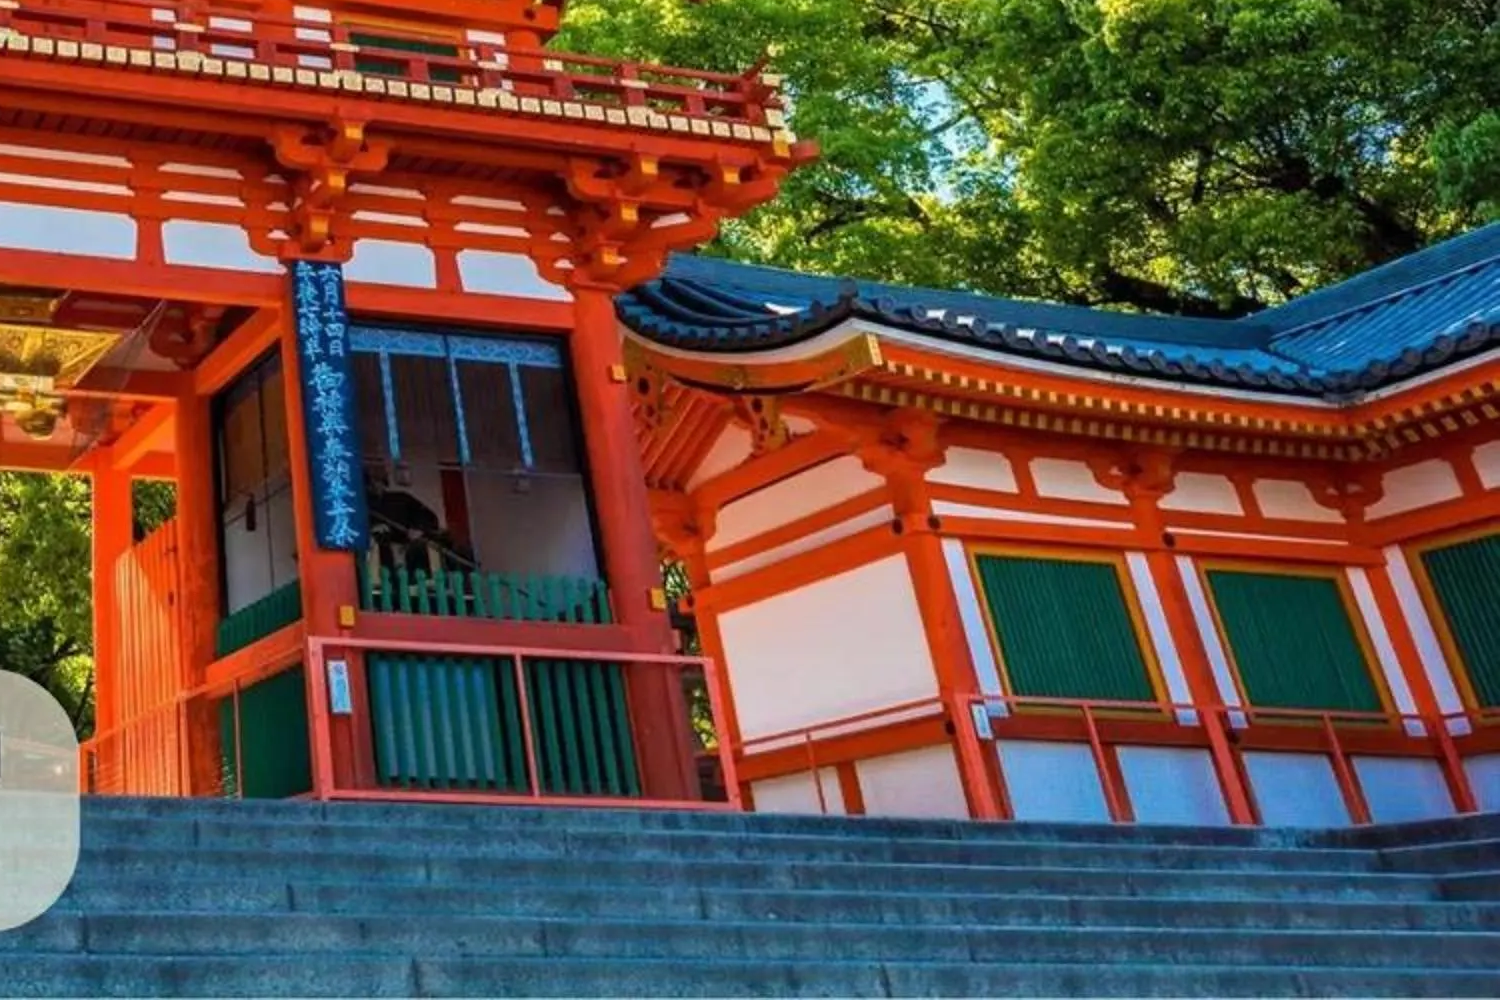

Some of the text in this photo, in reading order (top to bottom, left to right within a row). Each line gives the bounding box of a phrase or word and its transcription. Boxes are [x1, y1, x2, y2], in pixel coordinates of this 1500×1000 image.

[317, 264, 345, 357] 六月十四日
